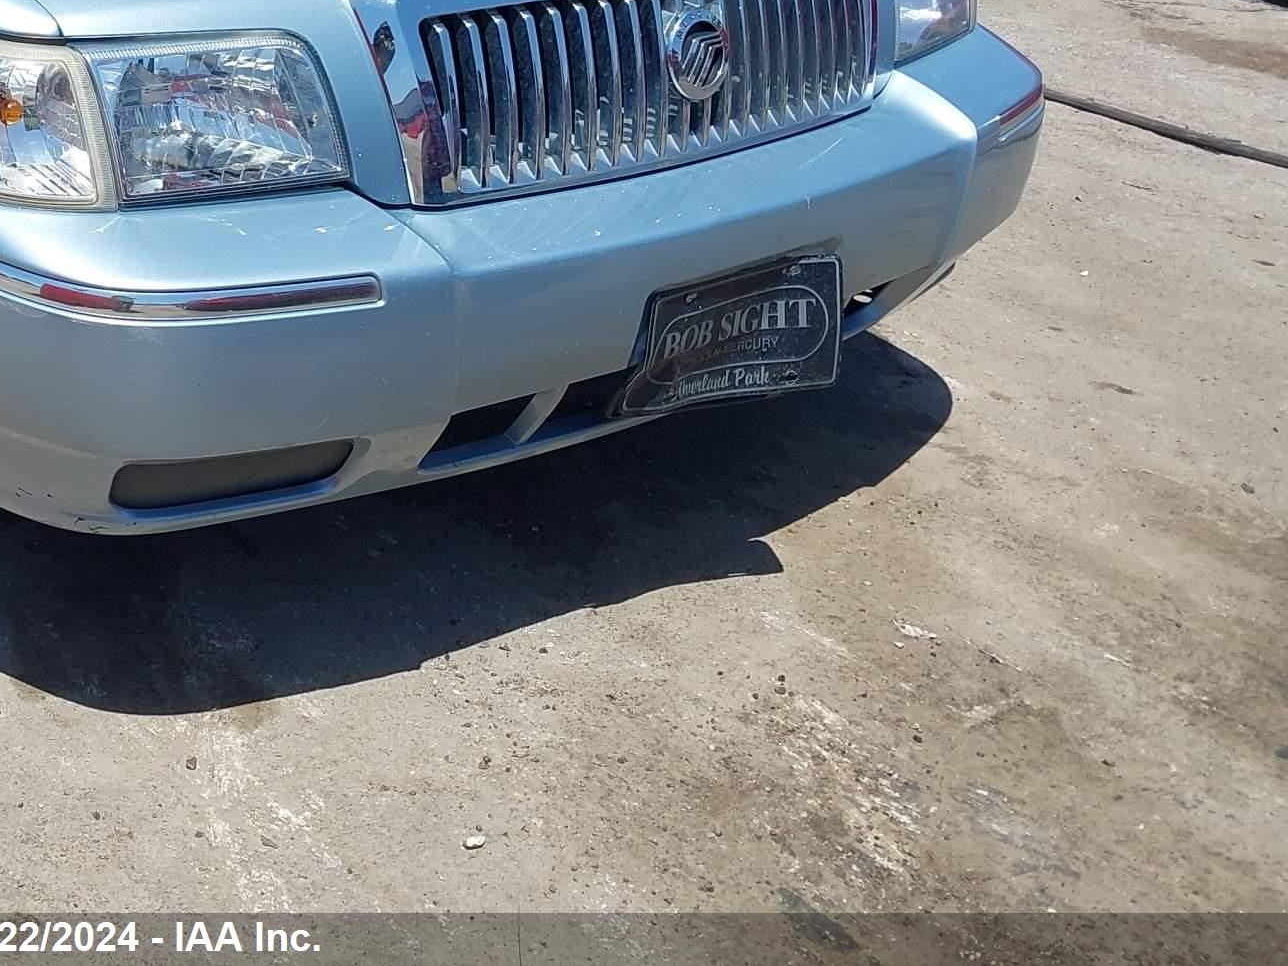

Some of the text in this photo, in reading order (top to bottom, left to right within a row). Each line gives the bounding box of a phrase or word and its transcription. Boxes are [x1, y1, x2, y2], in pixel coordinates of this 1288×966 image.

[664, 321, 713, 359] BOB
[719, 298, 816, 341] SIGHT
[733, 366, 770, 387] Park
